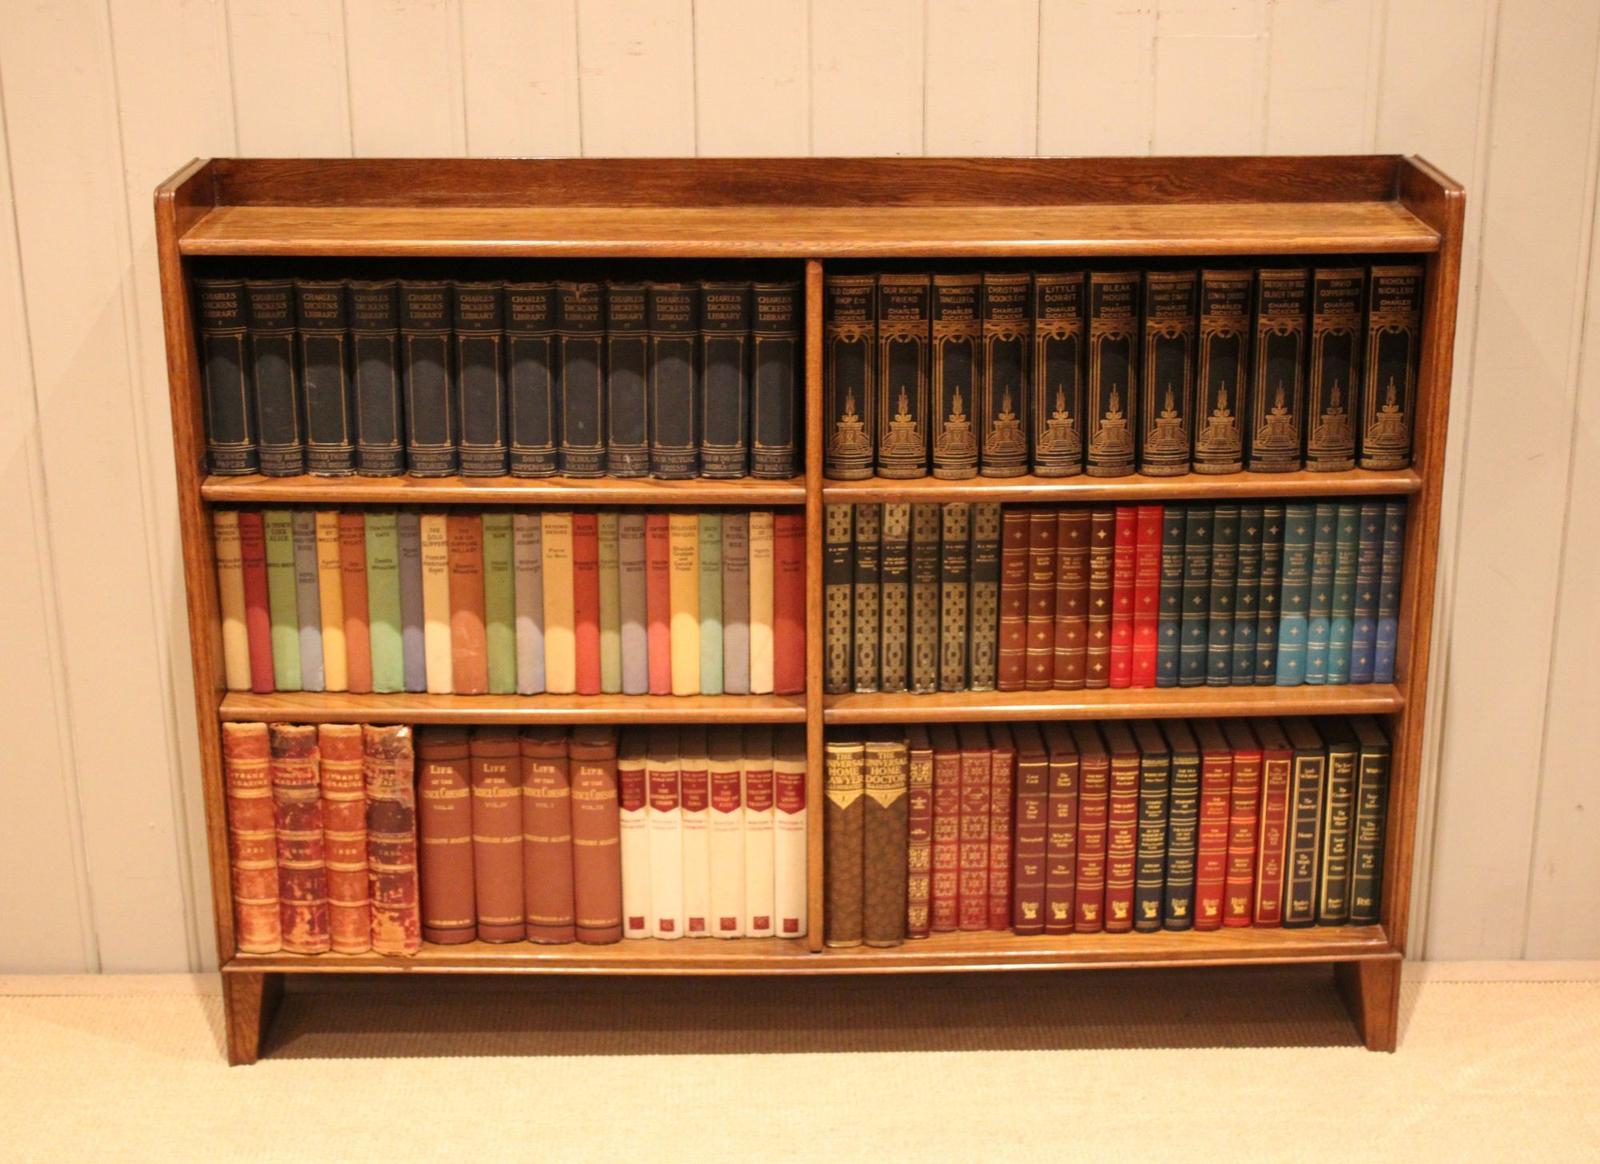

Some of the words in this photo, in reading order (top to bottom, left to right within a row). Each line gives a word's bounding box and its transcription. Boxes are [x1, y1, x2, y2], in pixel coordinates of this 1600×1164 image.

[1045, 285, 1077, 293] LITTLE
[303, 293, 338, 301] CHARLES
[511, 295, 546, 303] CHARLES
[609, 295, 645, 303] CHARLES
[656, 295, 690, 304] CHARLES
[706, 295, 742, 303] CHARLES
[757, 296, 792, 304] CHARLES
[1044, 293, 1076, 302] DORRIT
[1102, 293, 1131, 301] HOUSE
[304, 301, 338, 310] DICKENS
[460, 303, 495, 311] DICKENS
[610, 303, 645, 312] DICKENS
[656, 303, 690, 312] DICKENS
[707, 303, 742, 312] DICKENS
[758, 304, 793, 312] DICKENS
[304, 310, 337, 318] LIBRARY
[461, 311, 494, 320] LIBRARY
[513, 312, 545, 320] LIBRARY
[611, 312, 644, 321] LIBRARY
[657, 312, 689, 321] LIBRARY
[707, 312, 742, 320] LIBRARY
[758, 312, 792, 321] LIBRARY
[829, 767, 860, 776] HOME
[871, 766, 901, 775] HOME
[865, 775, 906, 784] DOCTOR
